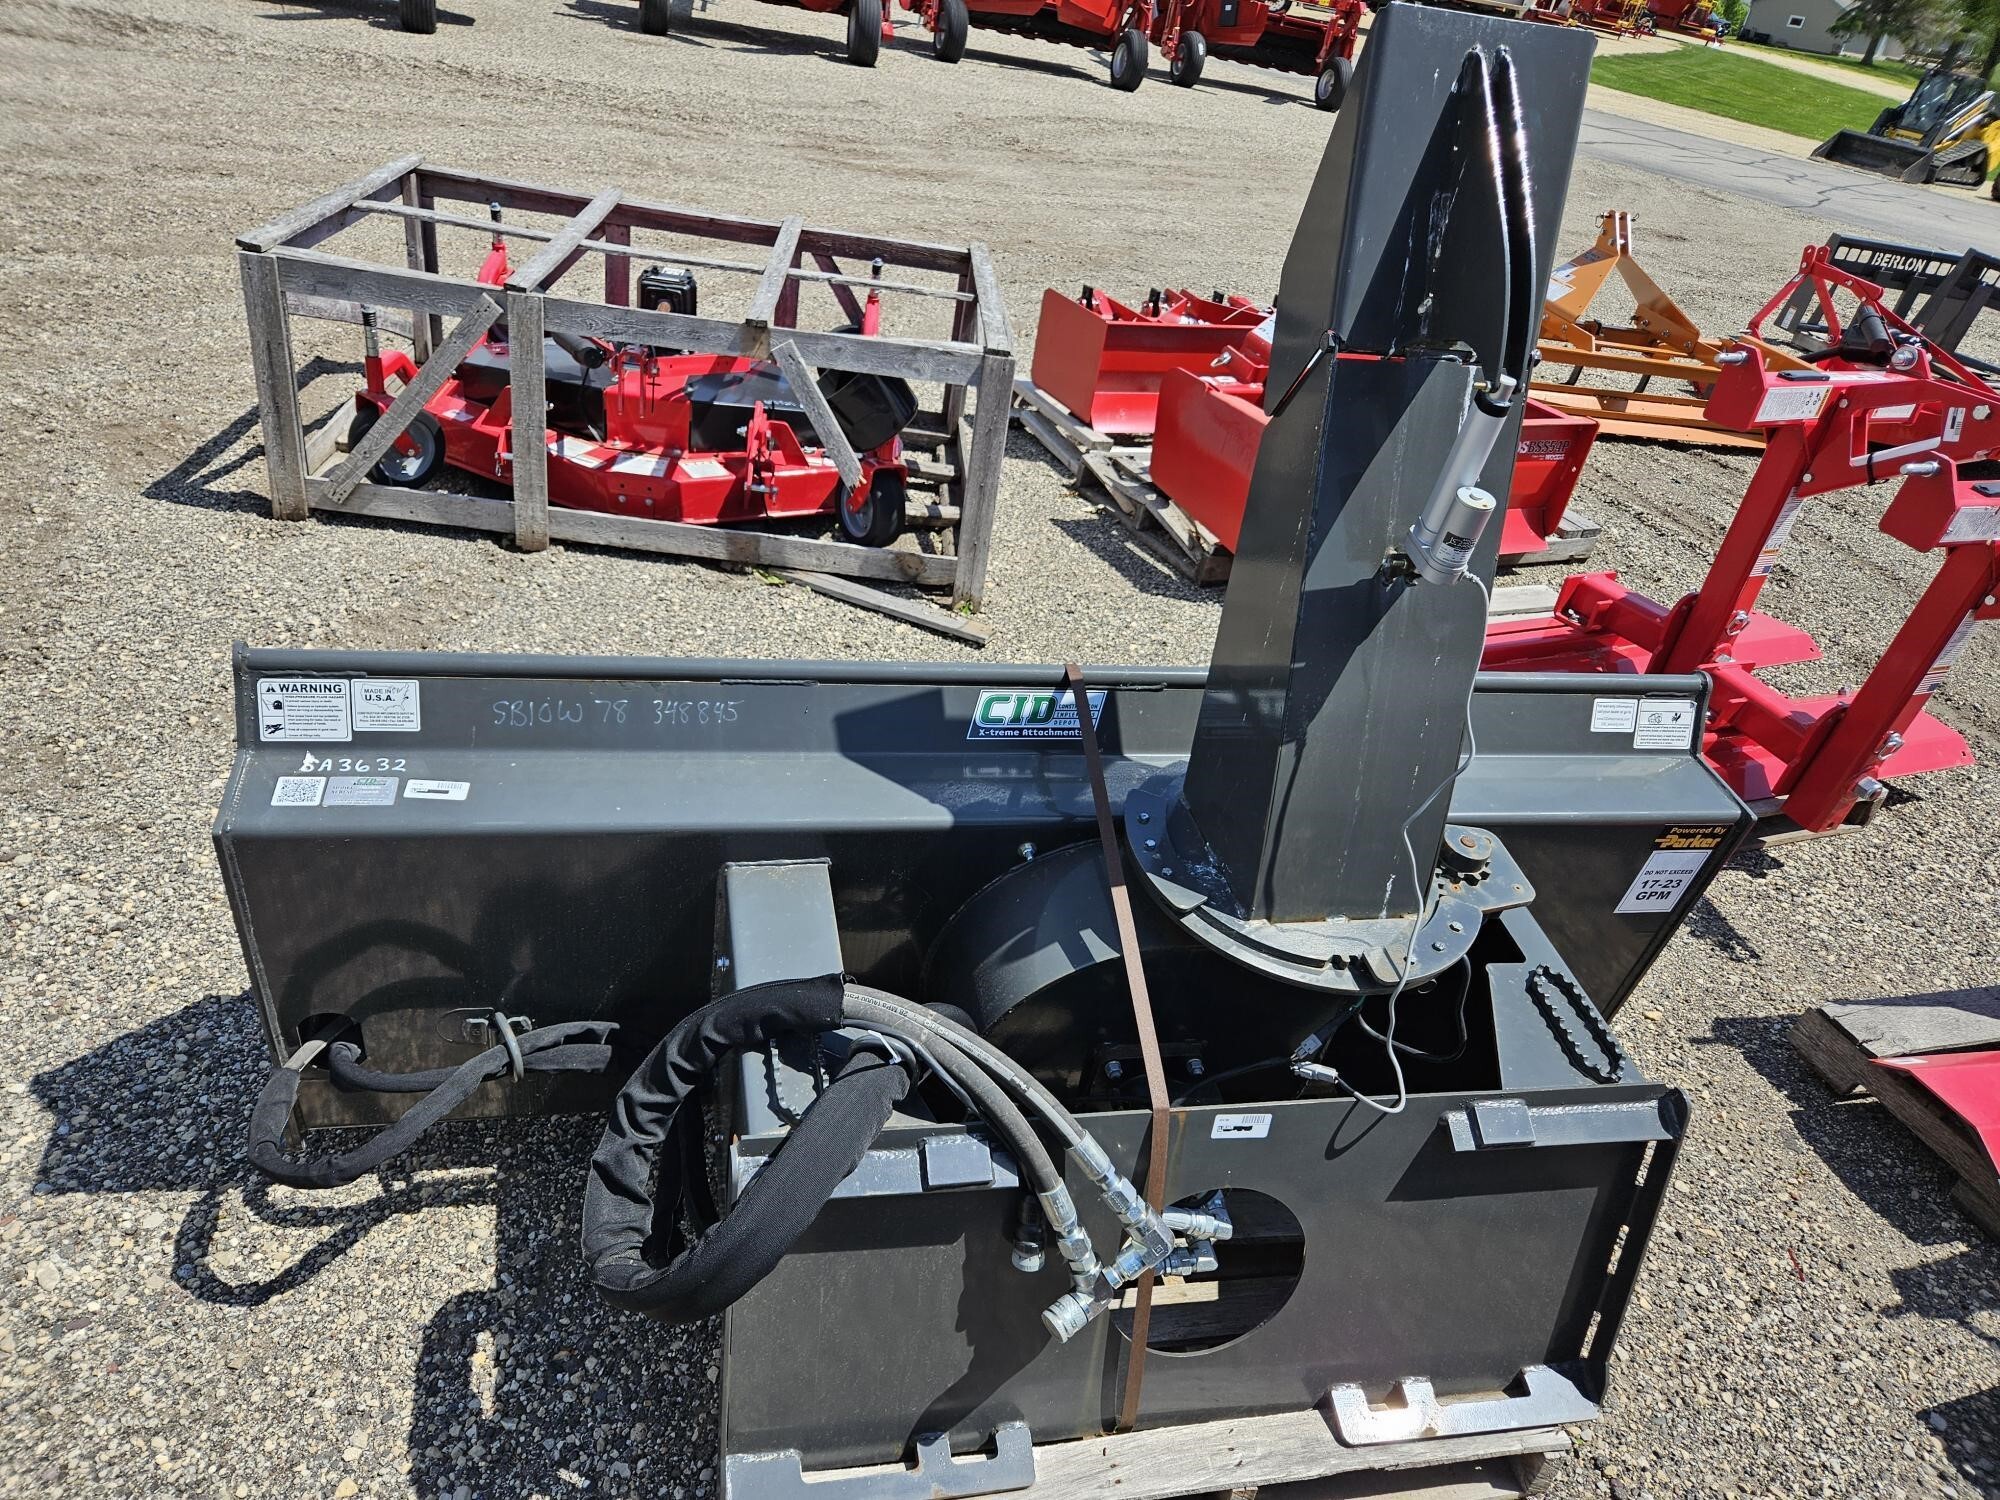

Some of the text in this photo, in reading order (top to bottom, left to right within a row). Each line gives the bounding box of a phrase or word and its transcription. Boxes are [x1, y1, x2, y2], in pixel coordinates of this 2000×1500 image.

[1871, 252, 1927, 273] BERLON
[278, 683, 342, 693] WARNING
[594, 699, 629, 723] 78
[979, 694, 1057, 725] CID
[978, 728, 1020, 736] X-treme
[1669, 826, 1727, 835] Powered By
[1655, 834, 1722, 848] Parker
[1641, 879, 1683, 889] 17-23
[1635, 891, 1672, 901] GPM
